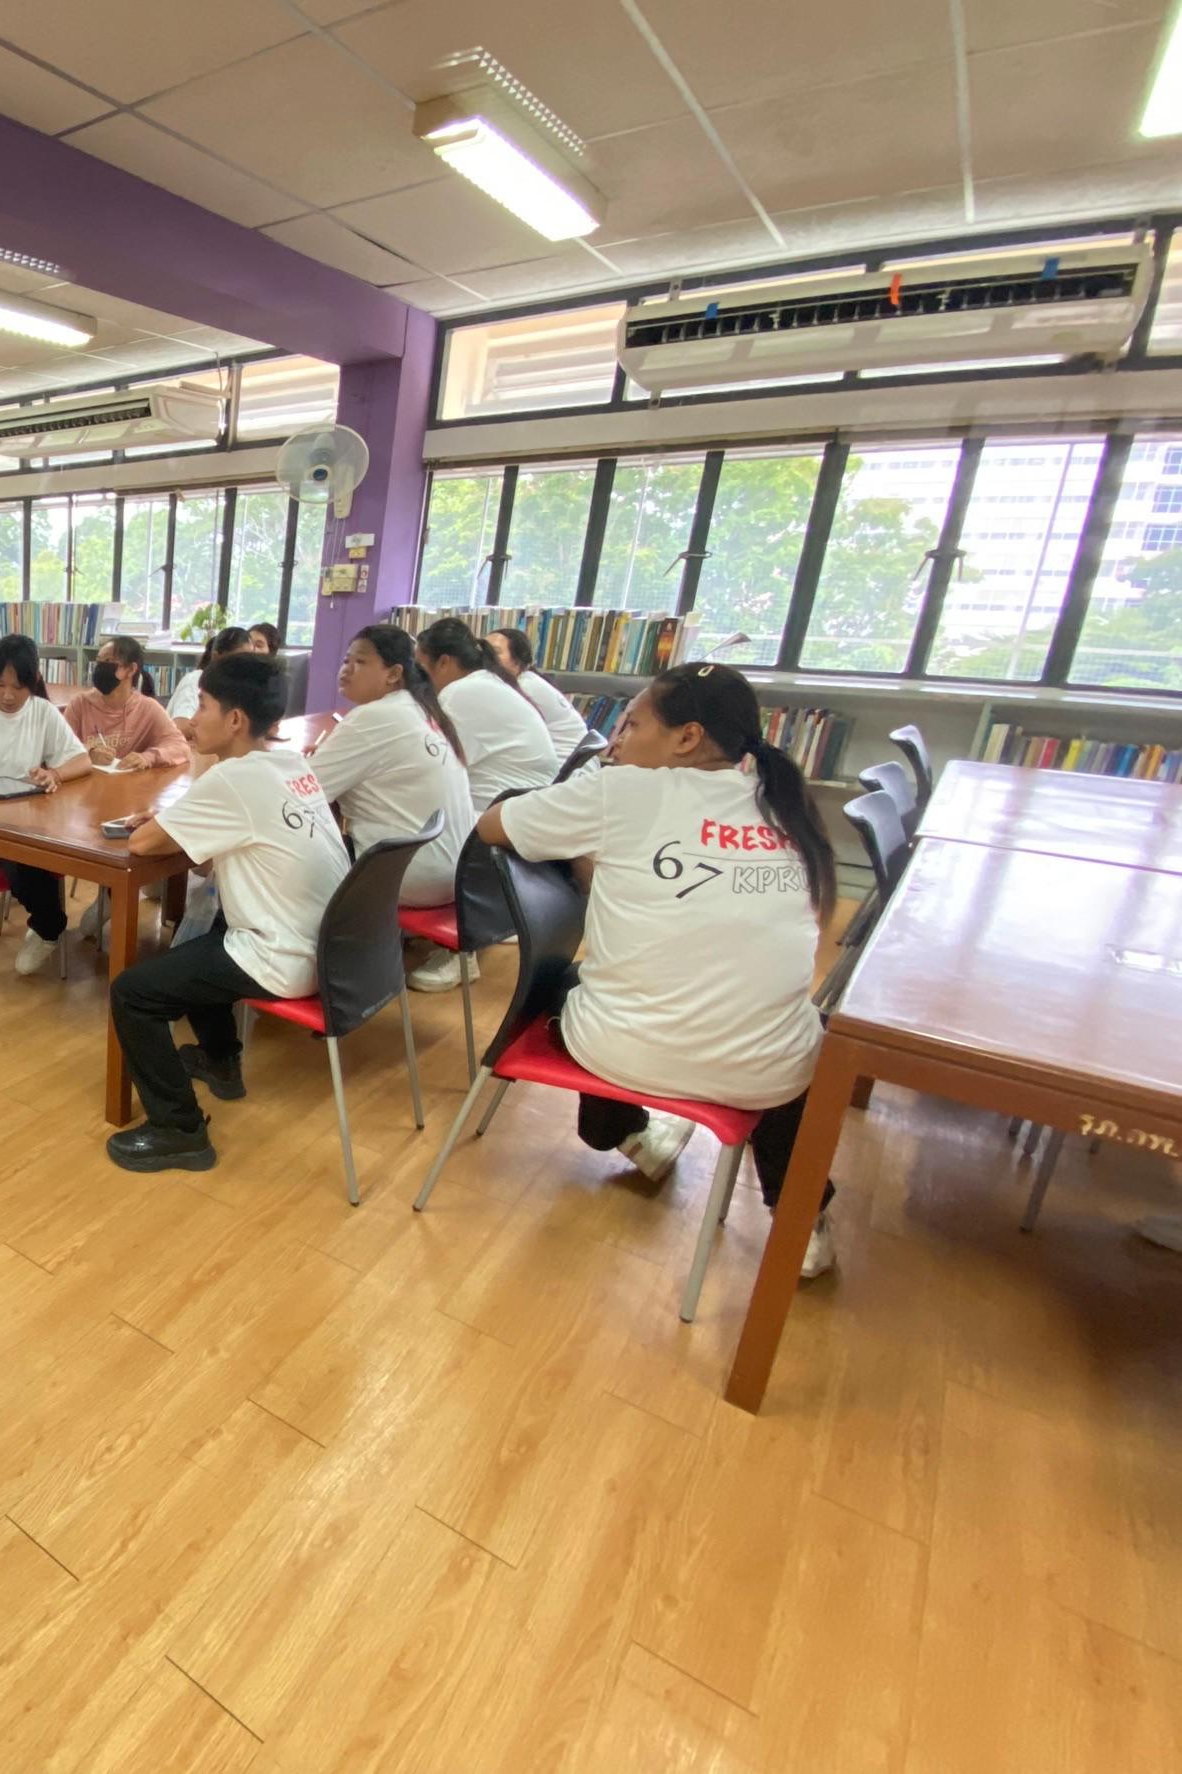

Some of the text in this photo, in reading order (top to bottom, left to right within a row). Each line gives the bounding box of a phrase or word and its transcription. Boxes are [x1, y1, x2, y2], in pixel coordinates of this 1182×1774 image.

[424, 734, 449, 766] 67
[282, 801, 316, 839] 67
[653, 840, 724, 899] 67
